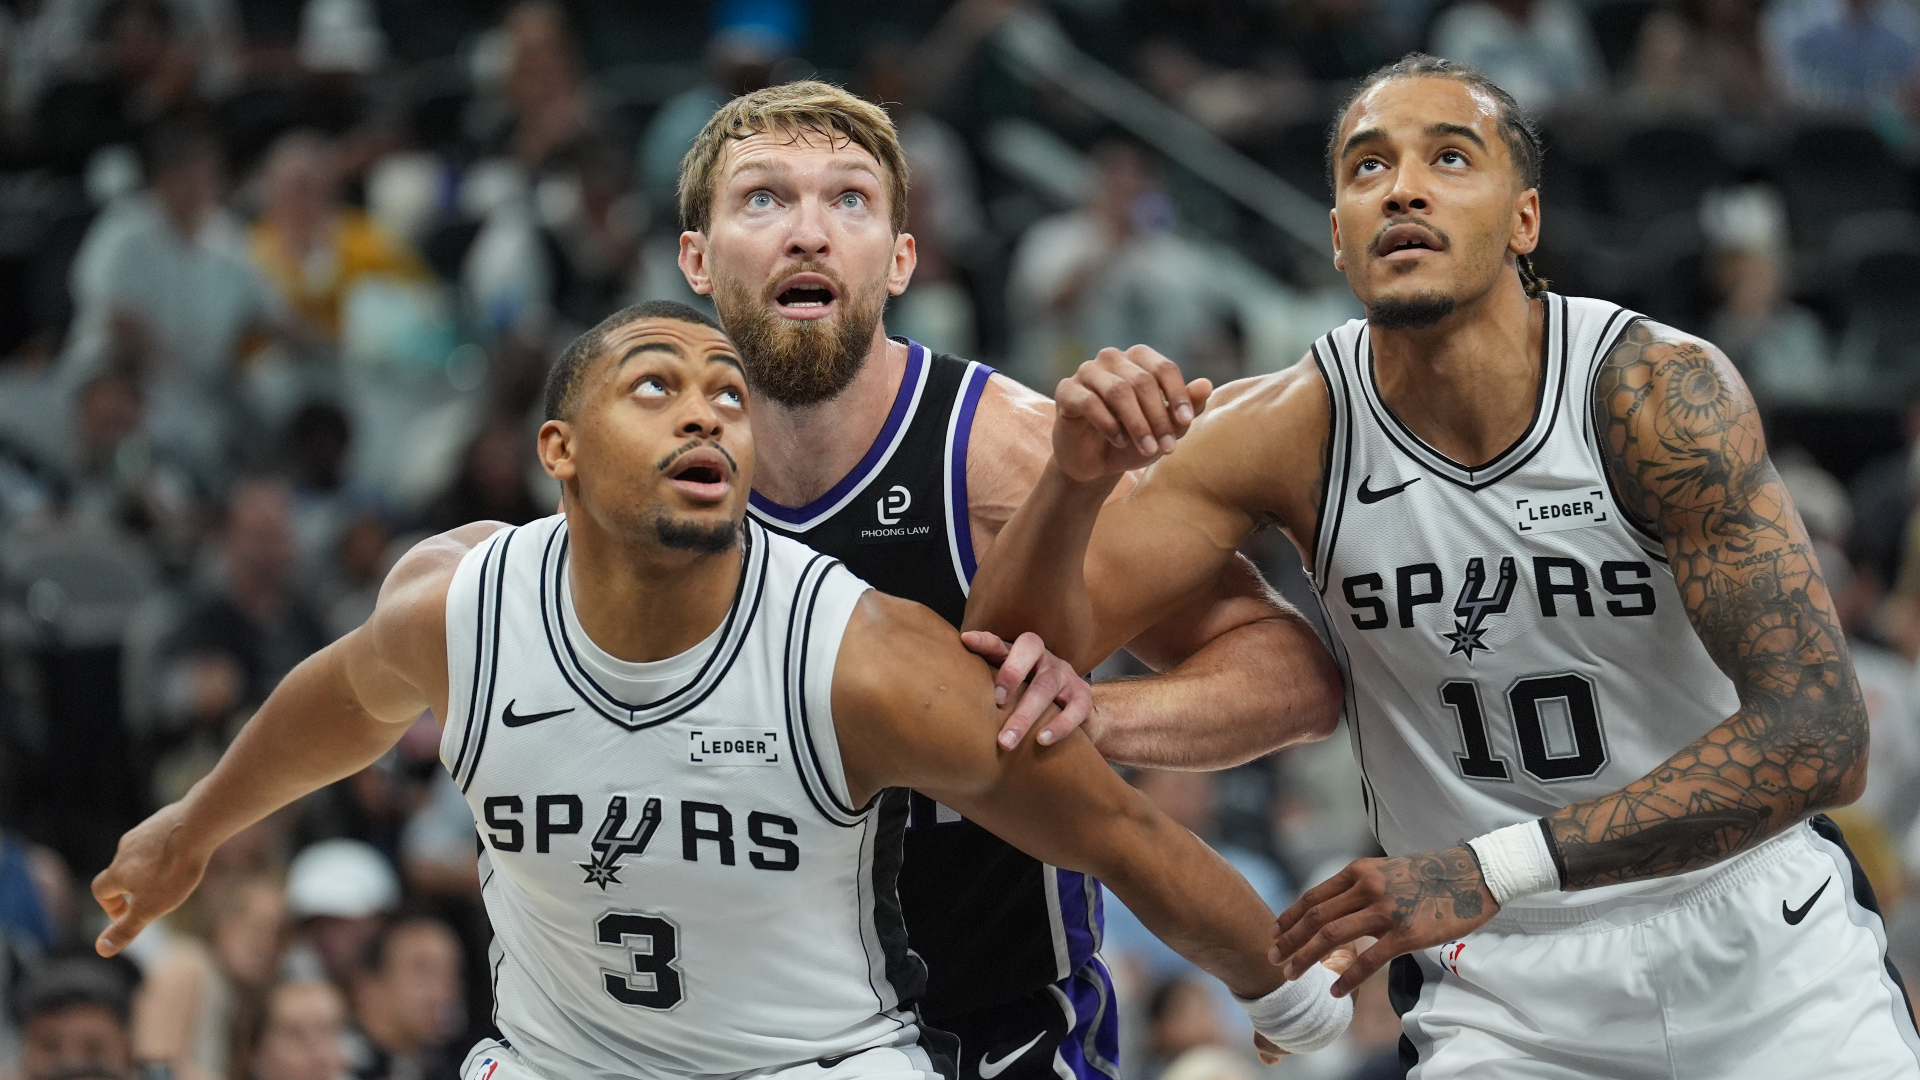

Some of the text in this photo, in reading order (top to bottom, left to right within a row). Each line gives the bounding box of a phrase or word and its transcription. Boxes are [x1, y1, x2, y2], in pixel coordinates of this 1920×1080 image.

[1675, 343, 1703, 360] hig
[1528, 500, 1594, 521] LEDGER
[861, 526, 930, 538] PHOONG LAW
[1734, 547, 1783, 570] never
[1341, 556, 1657, 665] SPURS
[1437, 670, 1611, 783] 10
[700, 739, 767, 755] LEDGER
[484, 793, 800, 890] SPURS
[593, 908, 687, 1012] 3
